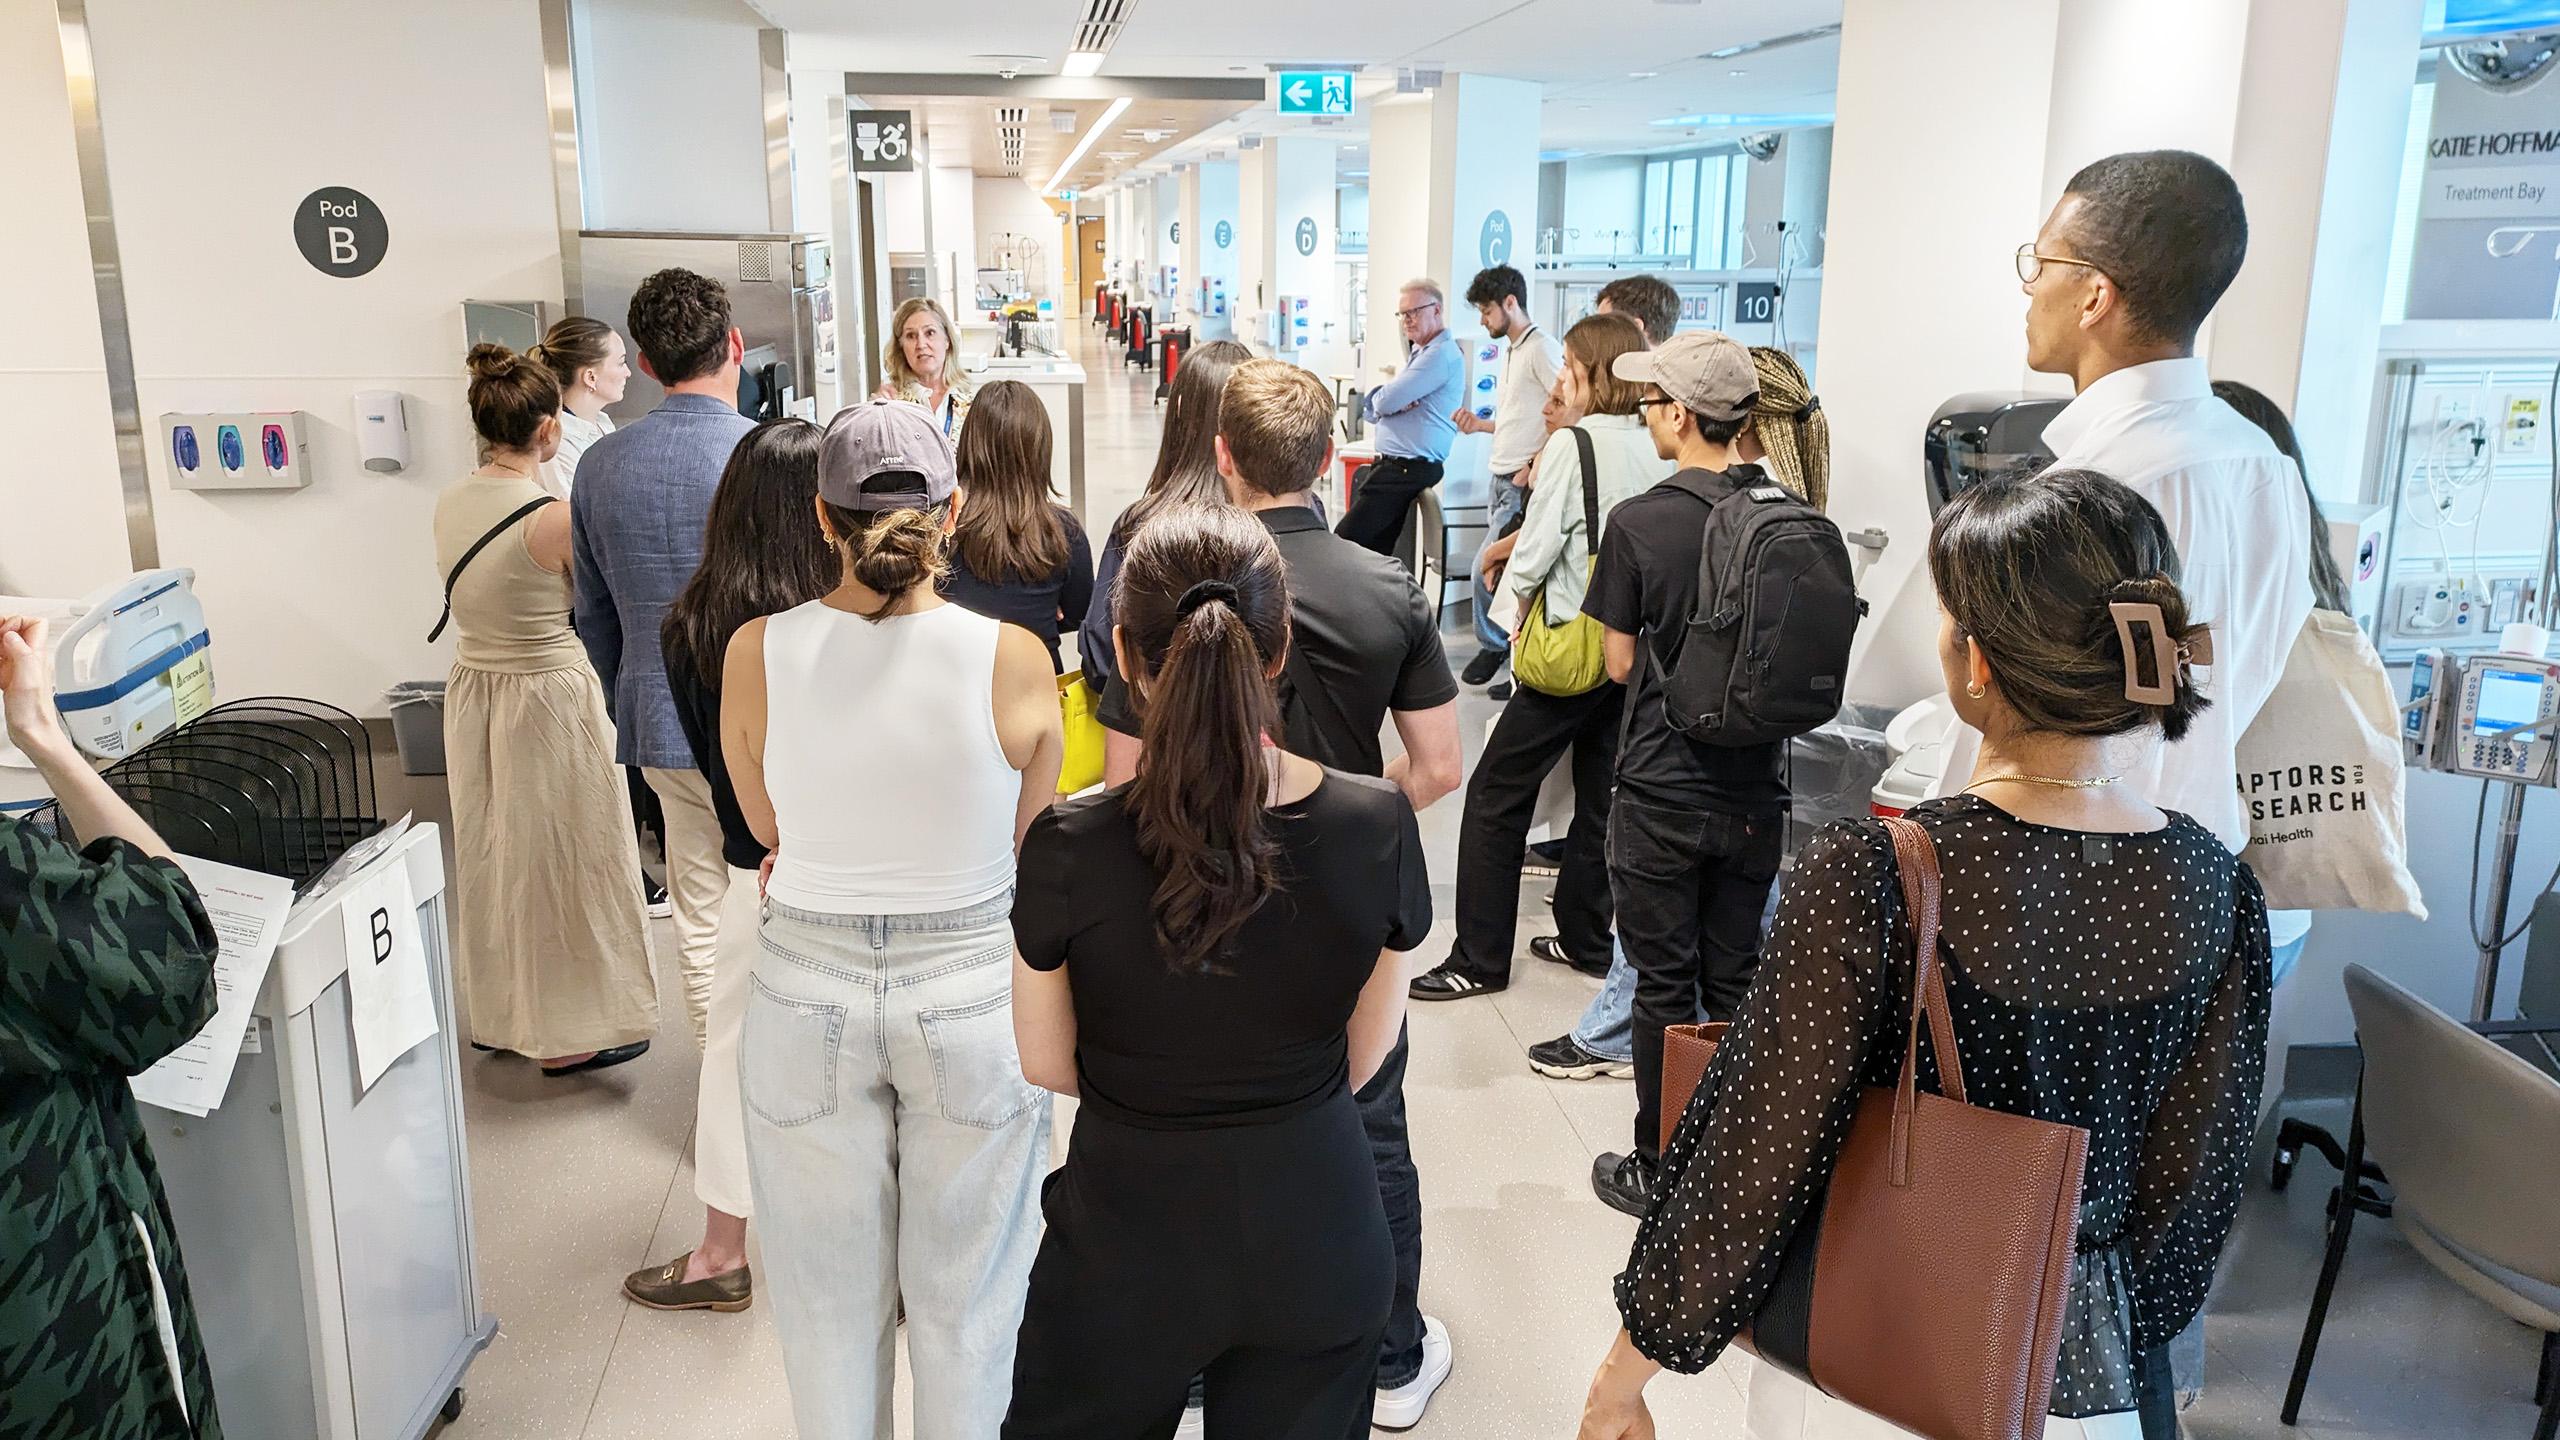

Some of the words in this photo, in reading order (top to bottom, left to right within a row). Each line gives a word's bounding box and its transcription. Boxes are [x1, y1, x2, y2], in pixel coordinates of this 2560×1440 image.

[2445, 184, 2514, 201] Treatment
[2518, 182, 2545, 204] Bay
[319, 199, 358, 218] Pod
[1489, 219, 1505, 232] Pod
[328, 226, 358, 264] B
[1220, 231, 1227, 245] E
[1302, 233, 1313, 251] D
[1489, 238, 1503, 266] C
[1744, 296, 1770, 319] 10
[2352, 764, 2364, 785] FOR
[2251, 790, 2366, 821] SEARCH
[2270, 827, 2313, 845] Health
[370, 906, 392, 966] B
